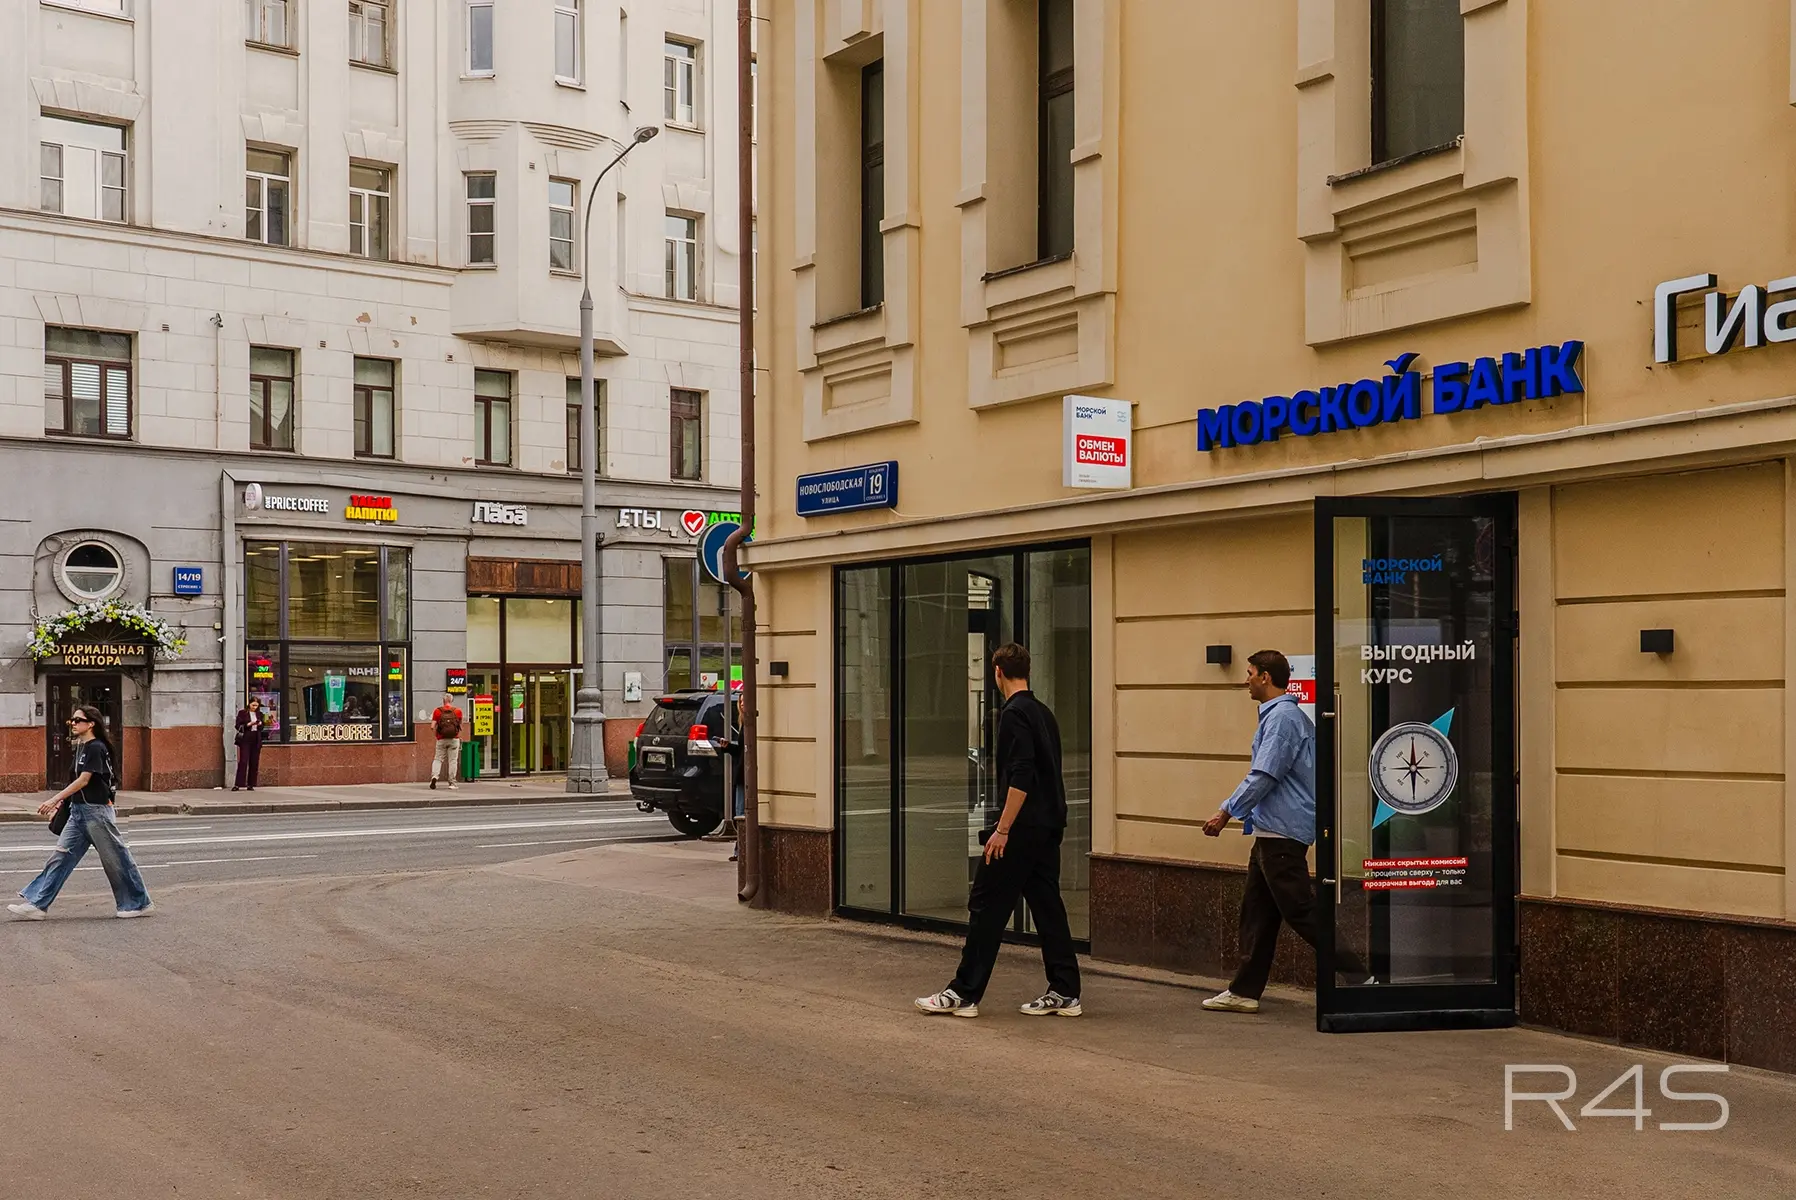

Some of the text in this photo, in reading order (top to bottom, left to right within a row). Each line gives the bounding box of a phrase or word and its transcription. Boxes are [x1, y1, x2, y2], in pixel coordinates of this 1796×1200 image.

[1197, 340, 1585, 451] МОРСКОЙ БАНК
[1076, 406, 1107, 415] МОРСКОЙ
[1079, 439, 1115, 451] ОБМЕН
[1079, 450, 1124, 463] ВАЛЮТЫ
[800, 477, 863, 496] НОВОСЛОБОДСКАЯ
[870, 473, 882, 495] 19
[271, 496, 297, 510] PRICE
[298, 498, 329, 512] COFFEE
[821, 496, 840, 504] УЛИЦА
[346, 506, 398, 520] НАПИТКИ
[472, 502, 527, 525] Лаба
[1362, 553, 1443, 571] МОРСКОЙ
[178, 573, 201, 581] 14/19
[1362, 572, 1406, 584] БАНК
[51, 644, 145, 656] ОТАРИАЛЬНАЯ
[1361, 640, 1475, 663] ВЫГОДНЫЙ
[64, 655, 122, 665] КОНТОРА
[450, 677, 465, 685] 24/7
[1361, 668, 1413, 684] КУРС
[304, 724, 335, 740] PRICE
[335, 724, 373, 740] COFFEE
[1397, 859, 1429, 867] скрытых
[1371, 869, 1408, 877] процентов
[1409, 869, 1434, 877] сверху
